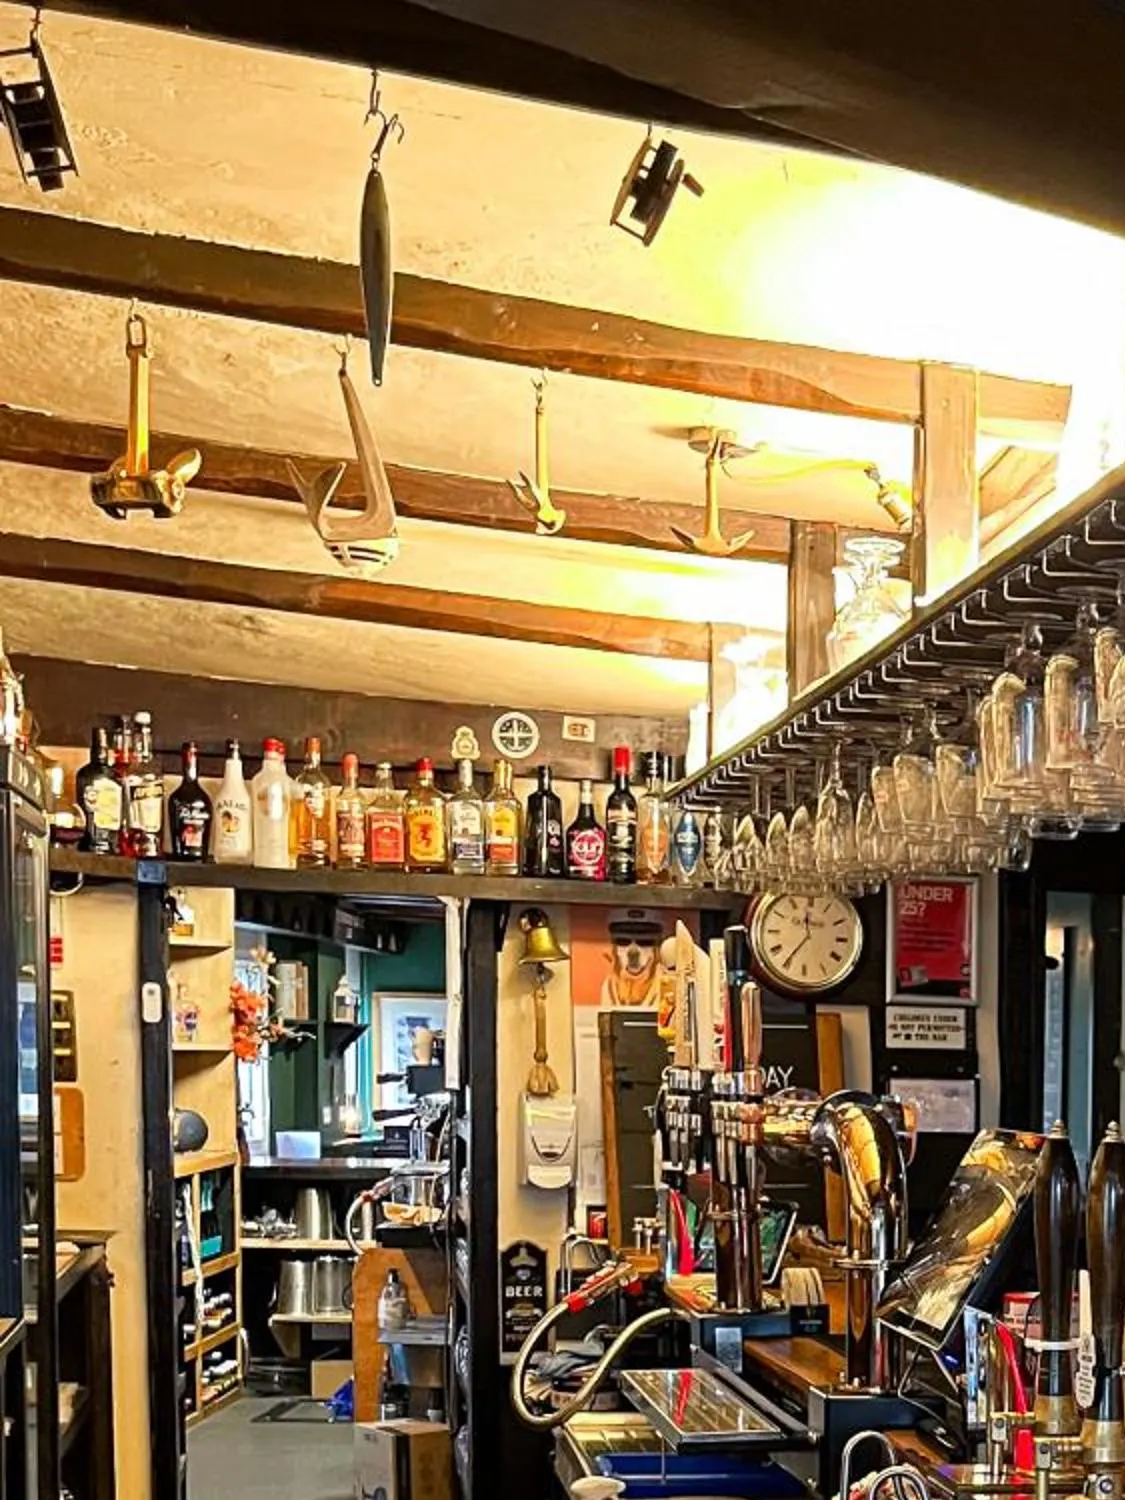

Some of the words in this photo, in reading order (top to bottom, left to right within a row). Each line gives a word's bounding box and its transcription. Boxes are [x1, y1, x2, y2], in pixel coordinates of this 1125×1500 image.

[899, 885, 953, 902] UNDER
[900, 901, 927, 917] 25?
[505, 1285, 543, 1297] BEER
